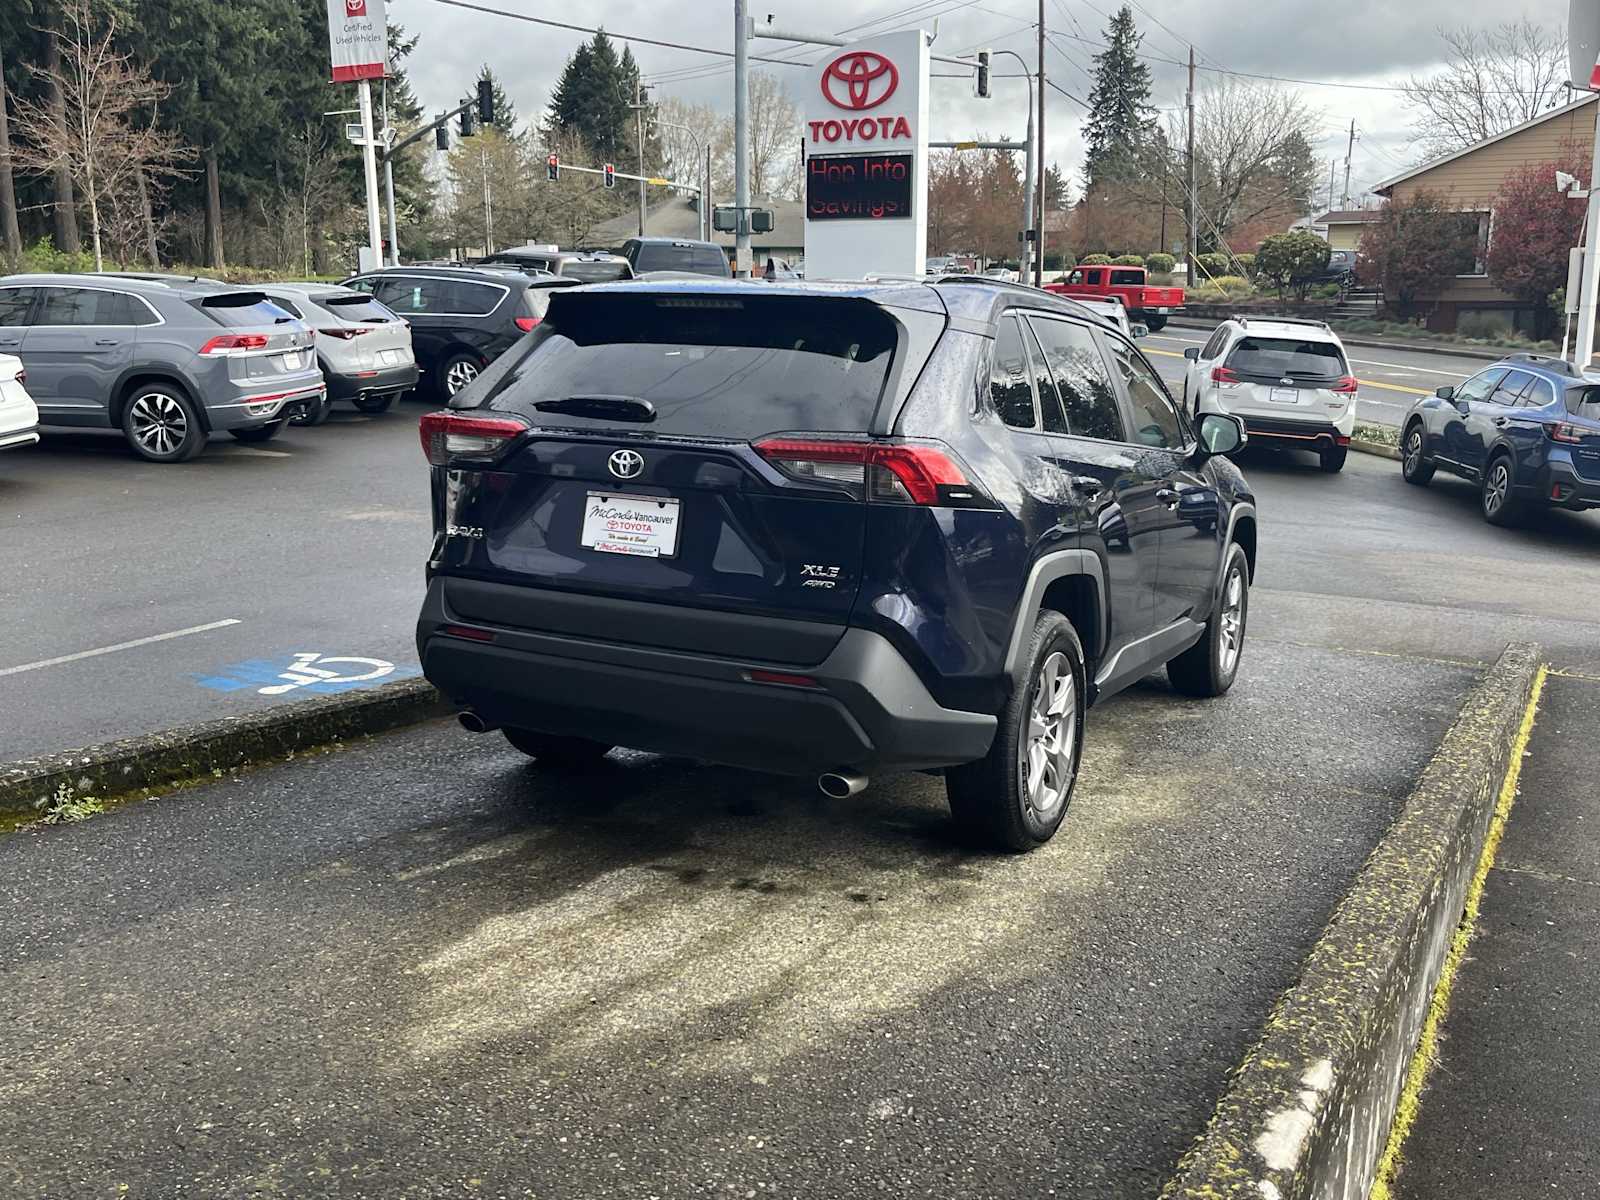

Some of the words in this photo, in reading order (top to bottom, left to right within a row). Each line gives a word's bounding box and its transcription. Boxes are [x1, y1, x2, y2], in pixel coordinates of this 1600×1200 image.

[343, 23, 372, 32] Certified
[335, 36, 353, 45] Used
[808, 117, 912, 143] TOYOTA
[864, 158, 906, 180] Into
[634, 511, 673, 525] Vancouver
[620, 522, 652, 532] TOYOTA
[800, 564, 840, 577] XLE
